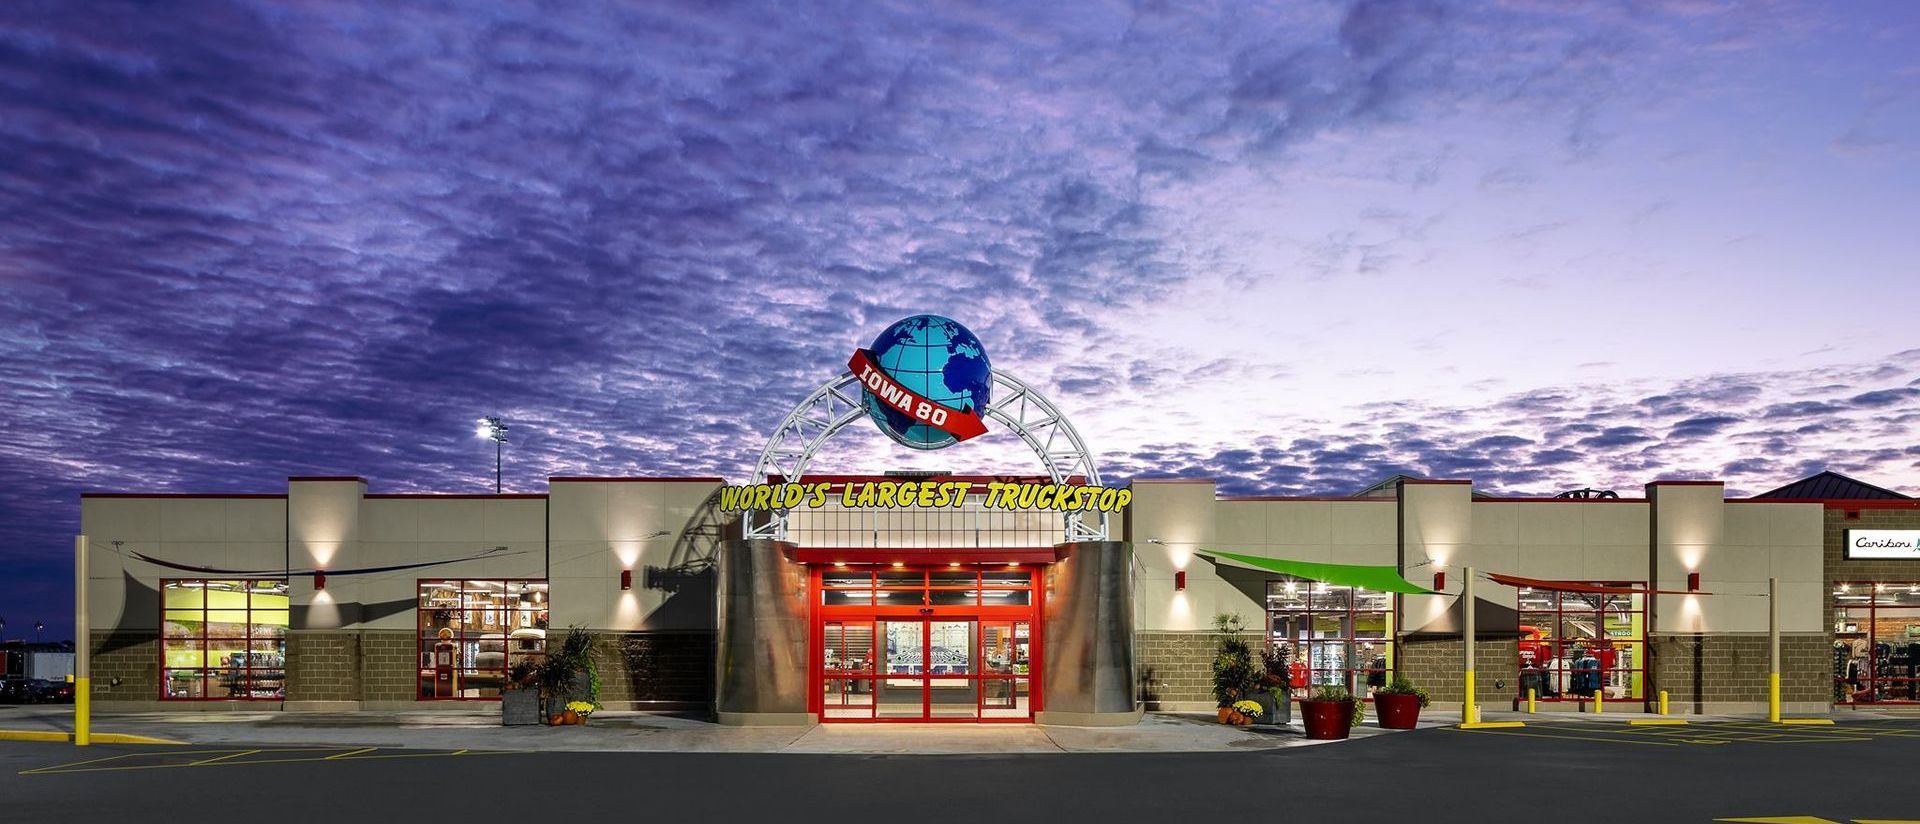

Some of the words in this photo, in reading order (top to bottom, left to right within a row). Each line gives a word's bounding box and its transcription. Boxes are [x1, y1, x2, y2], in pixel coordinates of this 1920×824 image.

[860, 364, 913, 412] IOWA
[915, 402, 948, 426] 80
[720, 482, 831, 511] WORLD'S
[842, 481, 972, 509] LARGEST
[984, 482, 1132, 513] TRUCKSTOP
[1855, 536, 1911, 548] Caribou
